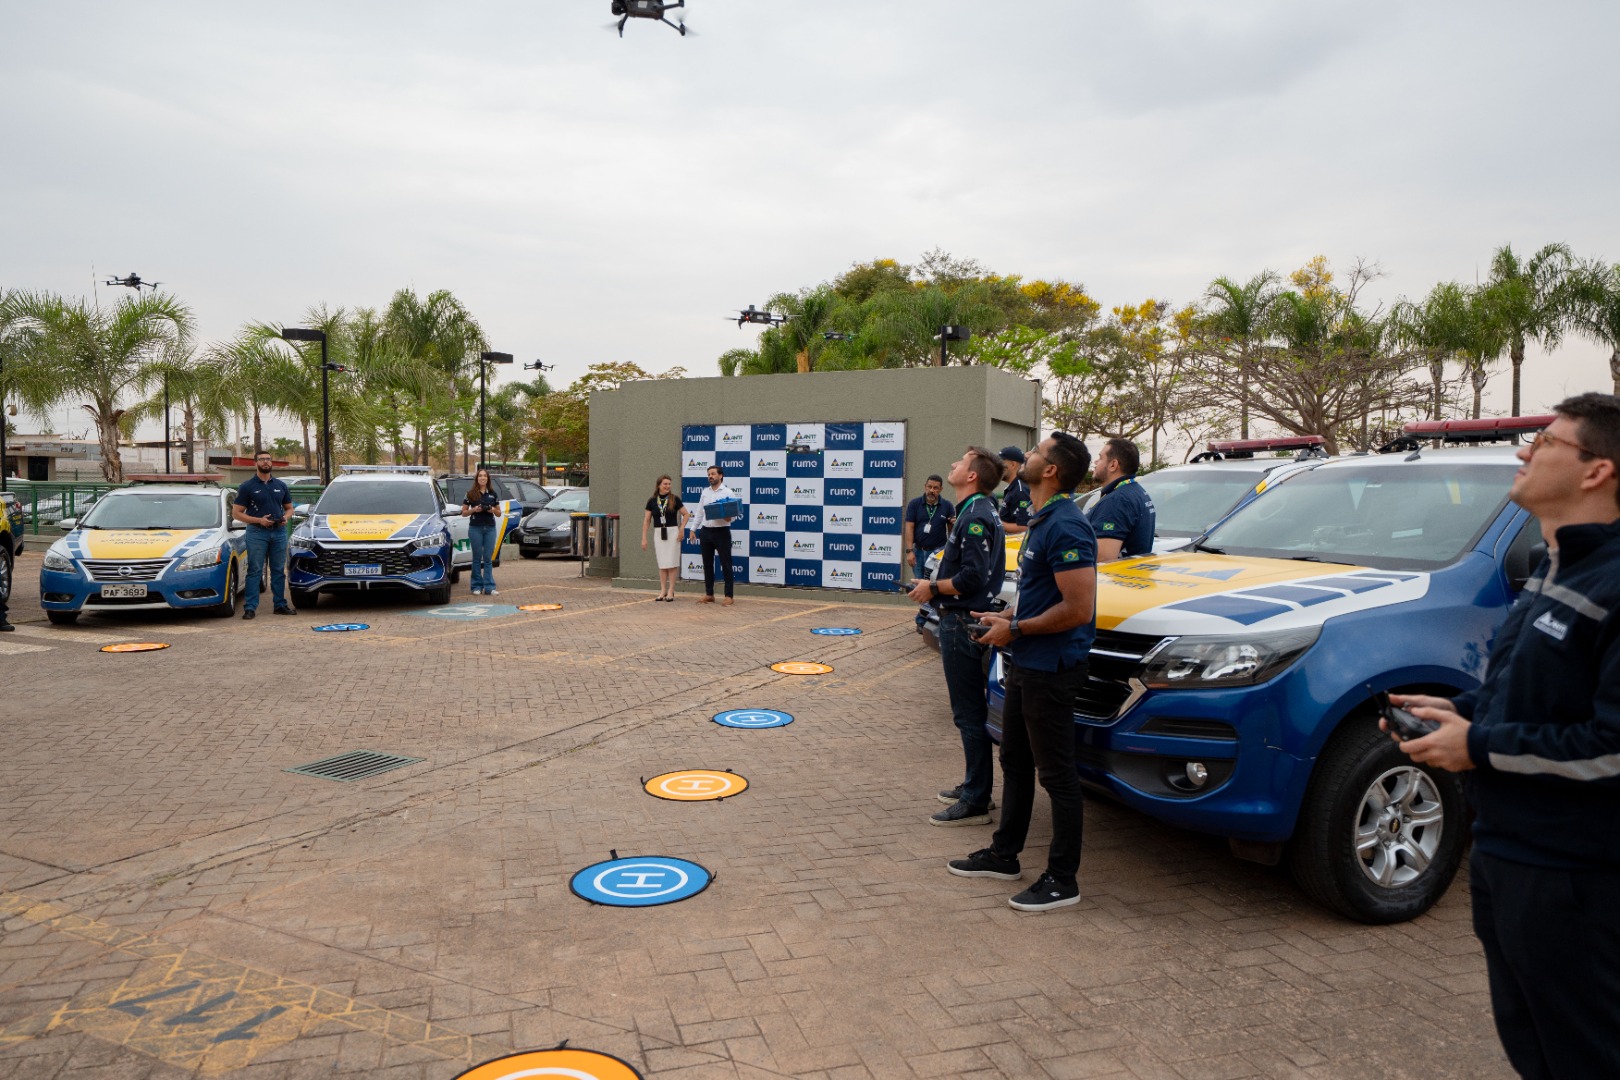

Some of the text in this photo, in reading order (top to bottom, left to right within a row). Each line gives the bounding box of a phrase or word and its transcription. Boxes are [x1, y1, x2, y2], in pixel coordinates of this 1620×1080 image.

[687, 434, 710, 442] rumo
[831, 432, 856, 440] rumo
[792, 460, 818, 468] rumo
[870, 460, 896, 468] rumo
[830, 488, 856, 496] rumo
[792, 514, 817, 522] rumo
[868, 516, 896, 524] rumo
[755, 540, 779, 548] rumo
[829, 543, 855, 551] rumo
[790, 568, 816, 576] rumo
[868, 572, 894, 580] rumo
[677, 780, 714, 790] H
[616, 872, 666, 888] H
